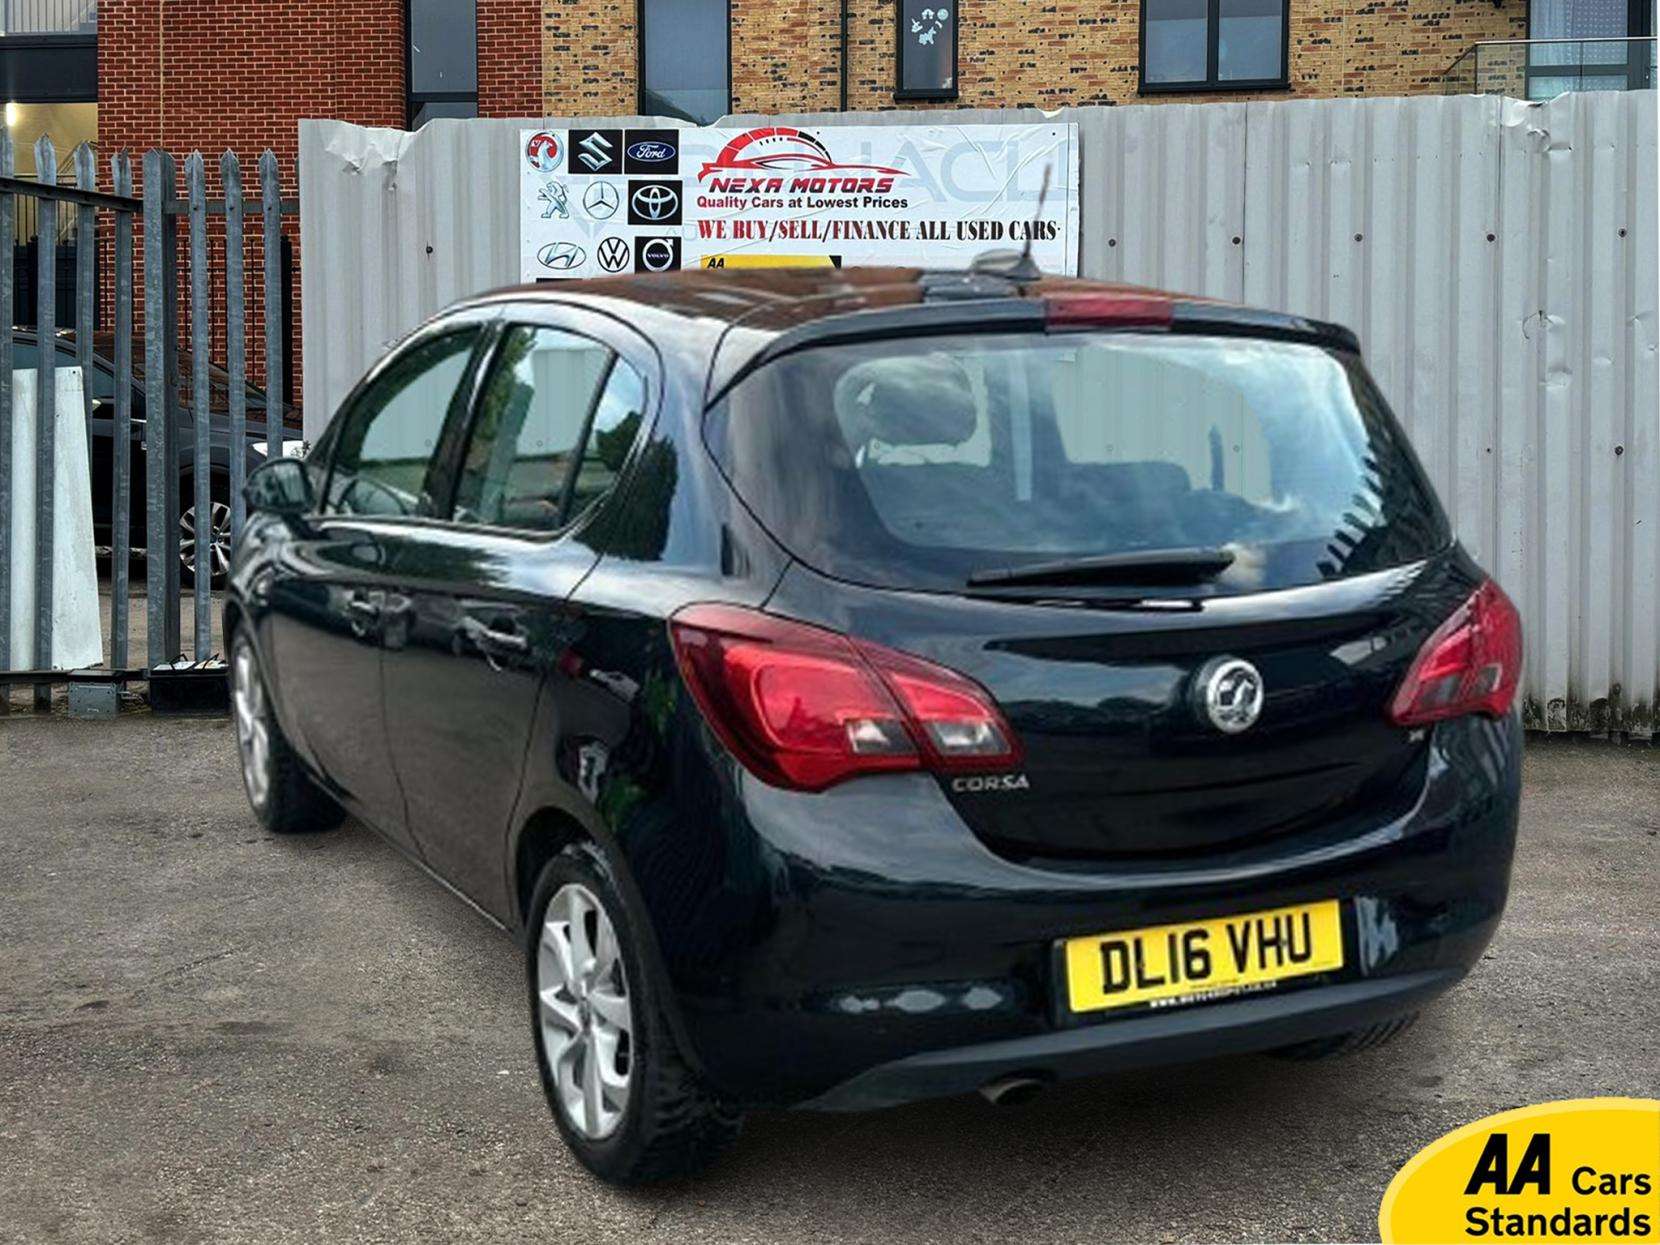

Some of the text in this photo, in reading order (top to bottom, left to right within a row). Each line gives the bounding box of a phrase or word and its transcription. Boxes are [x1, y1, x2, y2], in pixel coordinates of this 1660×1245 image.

[637, 144, 665, 158] Ford
[709, 178, 895, 193] NEXA MOTORS
[696, 196, 908, 210] Quality Cars at Lowest Prices
[697, 219, 1057, 242] WE BUY/SELL/FINANCE ALL USED CARS
[706, 257, 725, 269] AA
[952, 774, 1029, 791] CORSA
[1100, 929, 1212, 994] DL16
[1226, 912, 1312, 973] VHU
